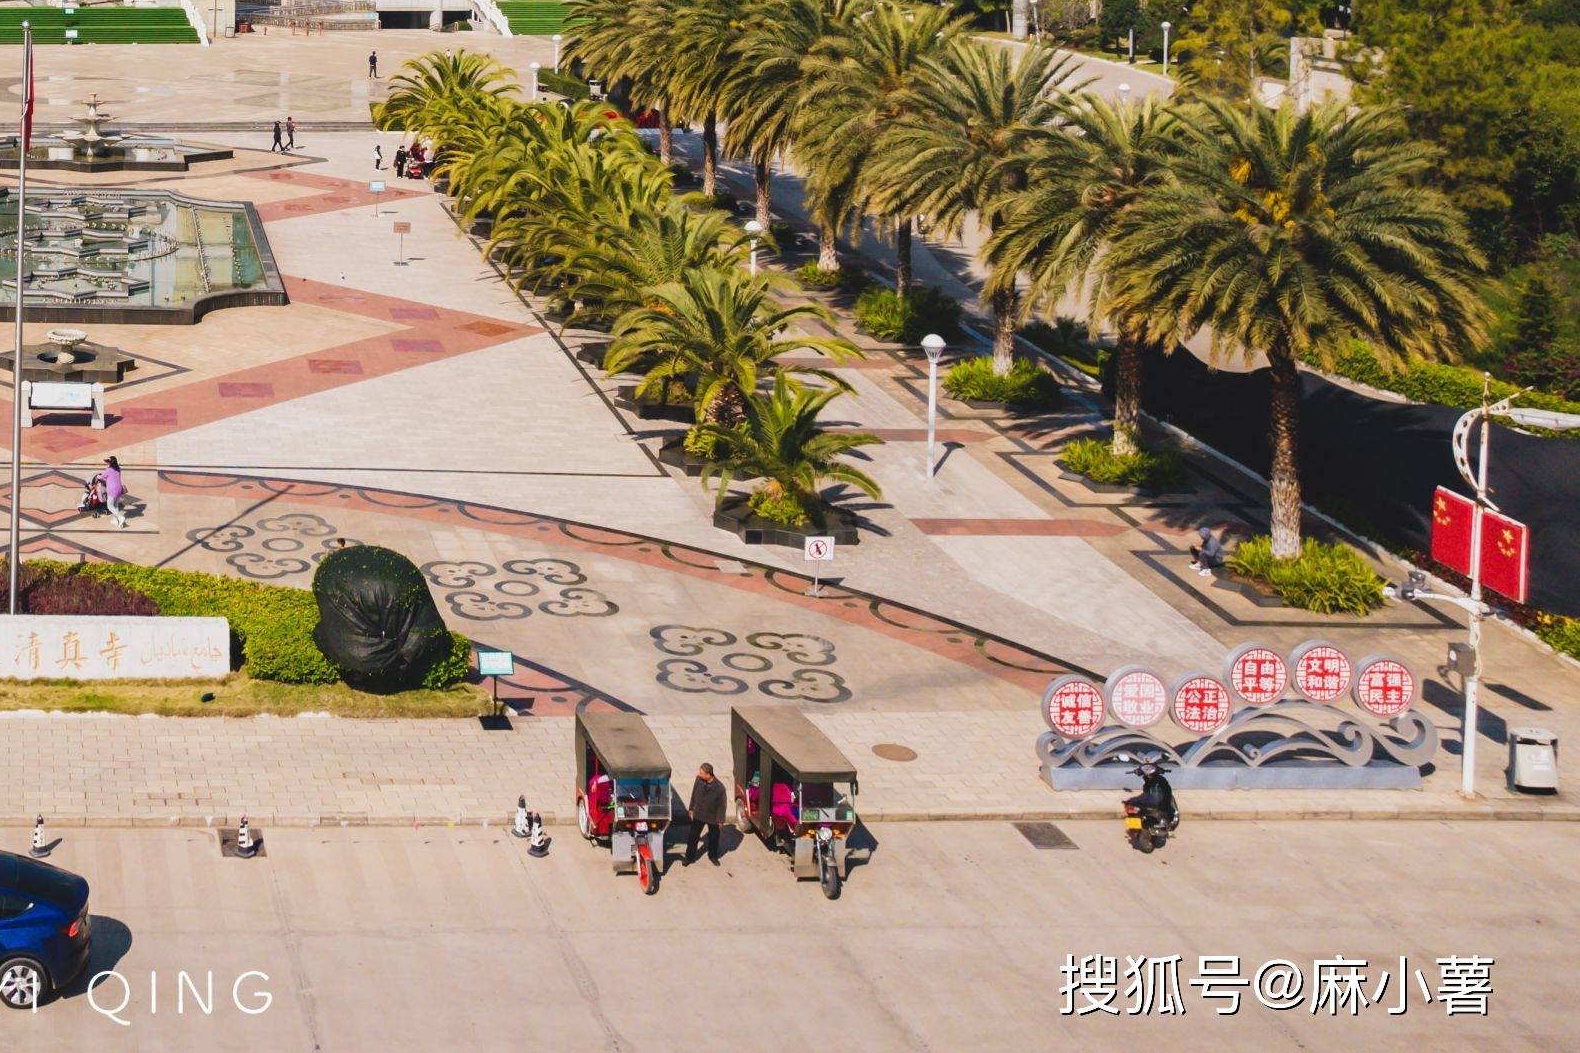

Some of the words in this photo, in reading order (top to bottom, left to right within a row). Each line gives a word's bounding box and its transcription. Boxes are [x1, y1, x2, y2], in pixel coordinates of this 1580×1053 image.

[1244, 661, 1274, 675] 自由
[1308, 659, 1339, 673] 文明
[1244, 677, 1274, 691] 平等
[1308, 675, 1339, 690] 和谐
[1370, 672, 1401, 687] 富强
[1061, 694, 1092, 708] 诚信
[1186, 690, 1217, 703] 公正
[1370, 689, 1401, 703] 民主
[1061, 711, 1092, 725] 友善
[1186, 706, 1218, 720] 法治
